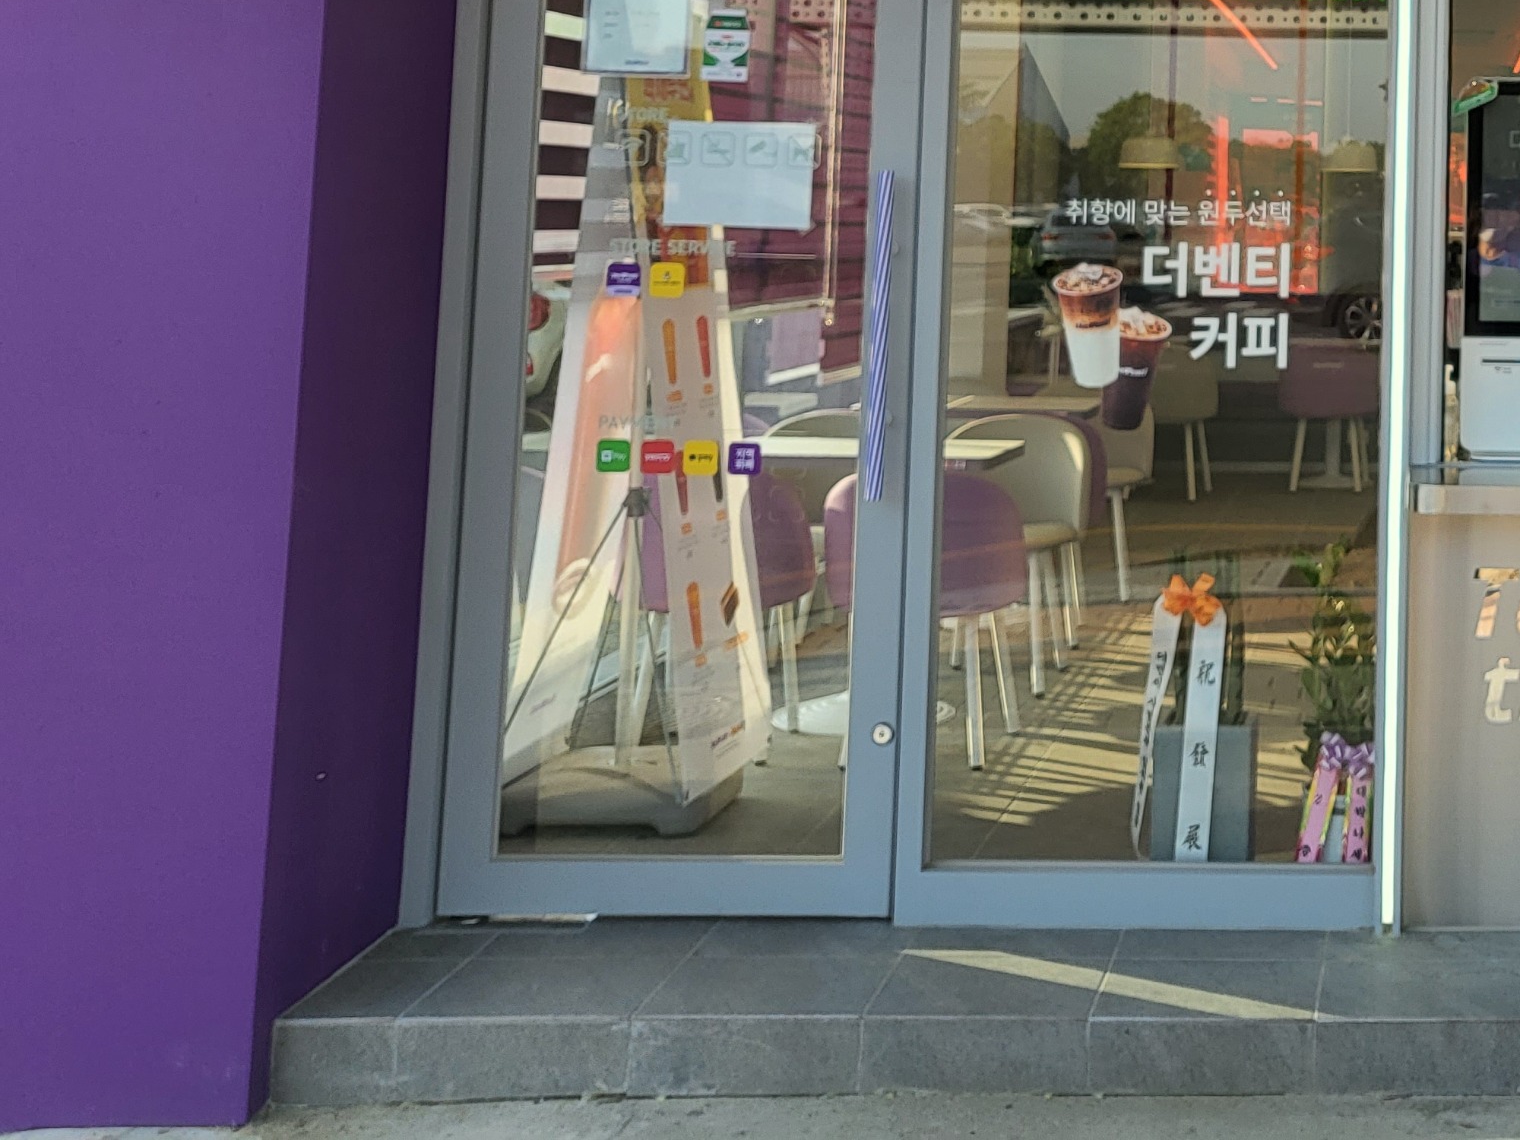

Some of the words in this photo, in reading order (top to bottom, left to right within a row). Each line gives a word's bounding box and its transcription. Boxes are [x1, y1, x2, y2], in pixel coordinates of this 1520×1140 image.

[1065, 197, 1136, 225] 취향에
[1144, 198, 1191, 226] 맞는
[1198, 199, 1292, 227] 원두선택
[609, 238, 662, 256] STORE
[1142, 241, 1292, 299] 더벤티
[1189, 311, 1290, 370] 커피
